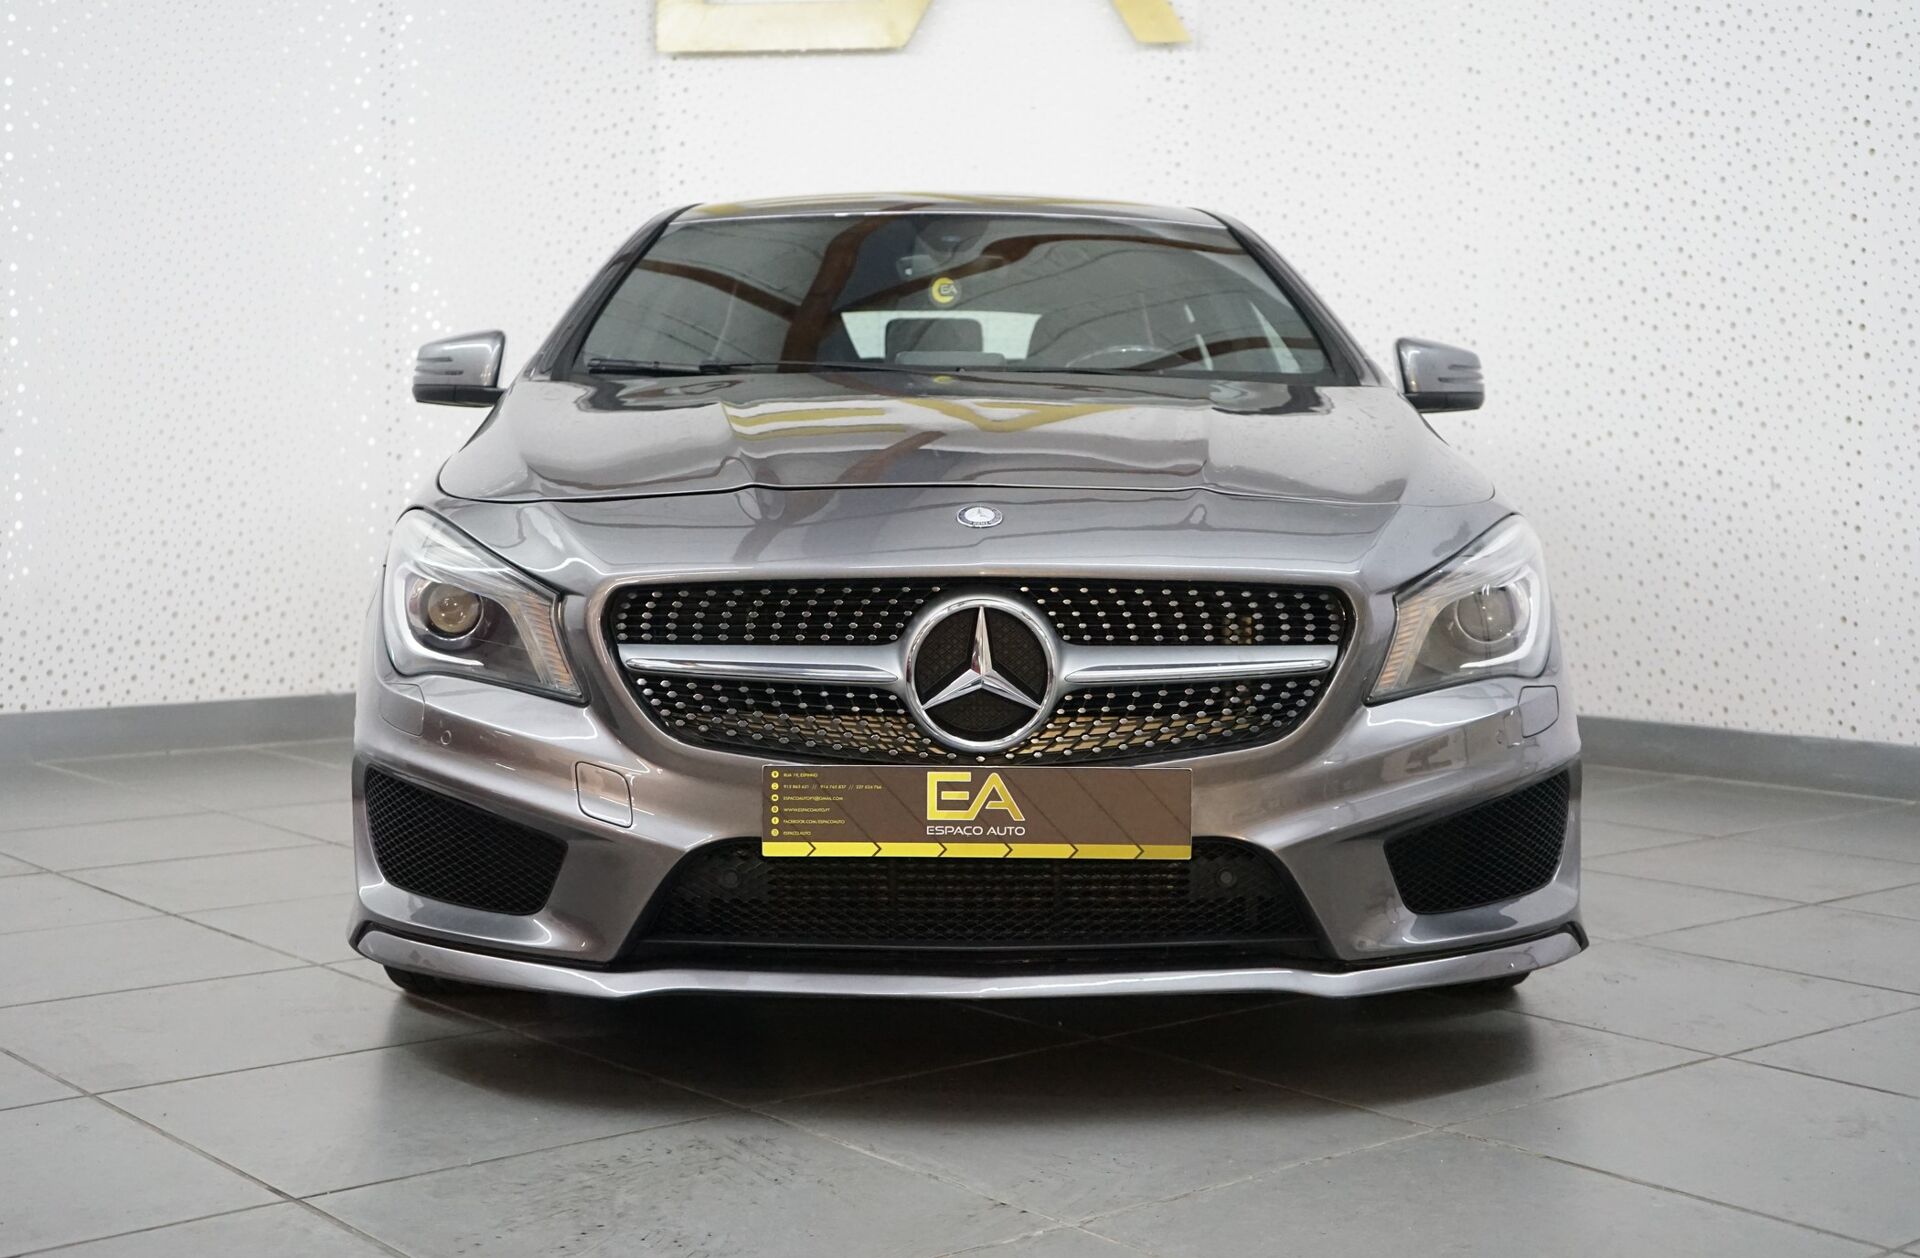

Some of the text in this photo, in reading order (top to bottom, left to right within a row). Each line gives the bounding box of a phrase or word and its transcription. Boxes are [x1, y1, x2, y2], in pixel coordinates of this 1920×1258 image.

[940, 284, 958, 294] EA
[926, 771, 1026, 821] EA
[926, 825, 1026, 837] ESPAÇO AUTO
